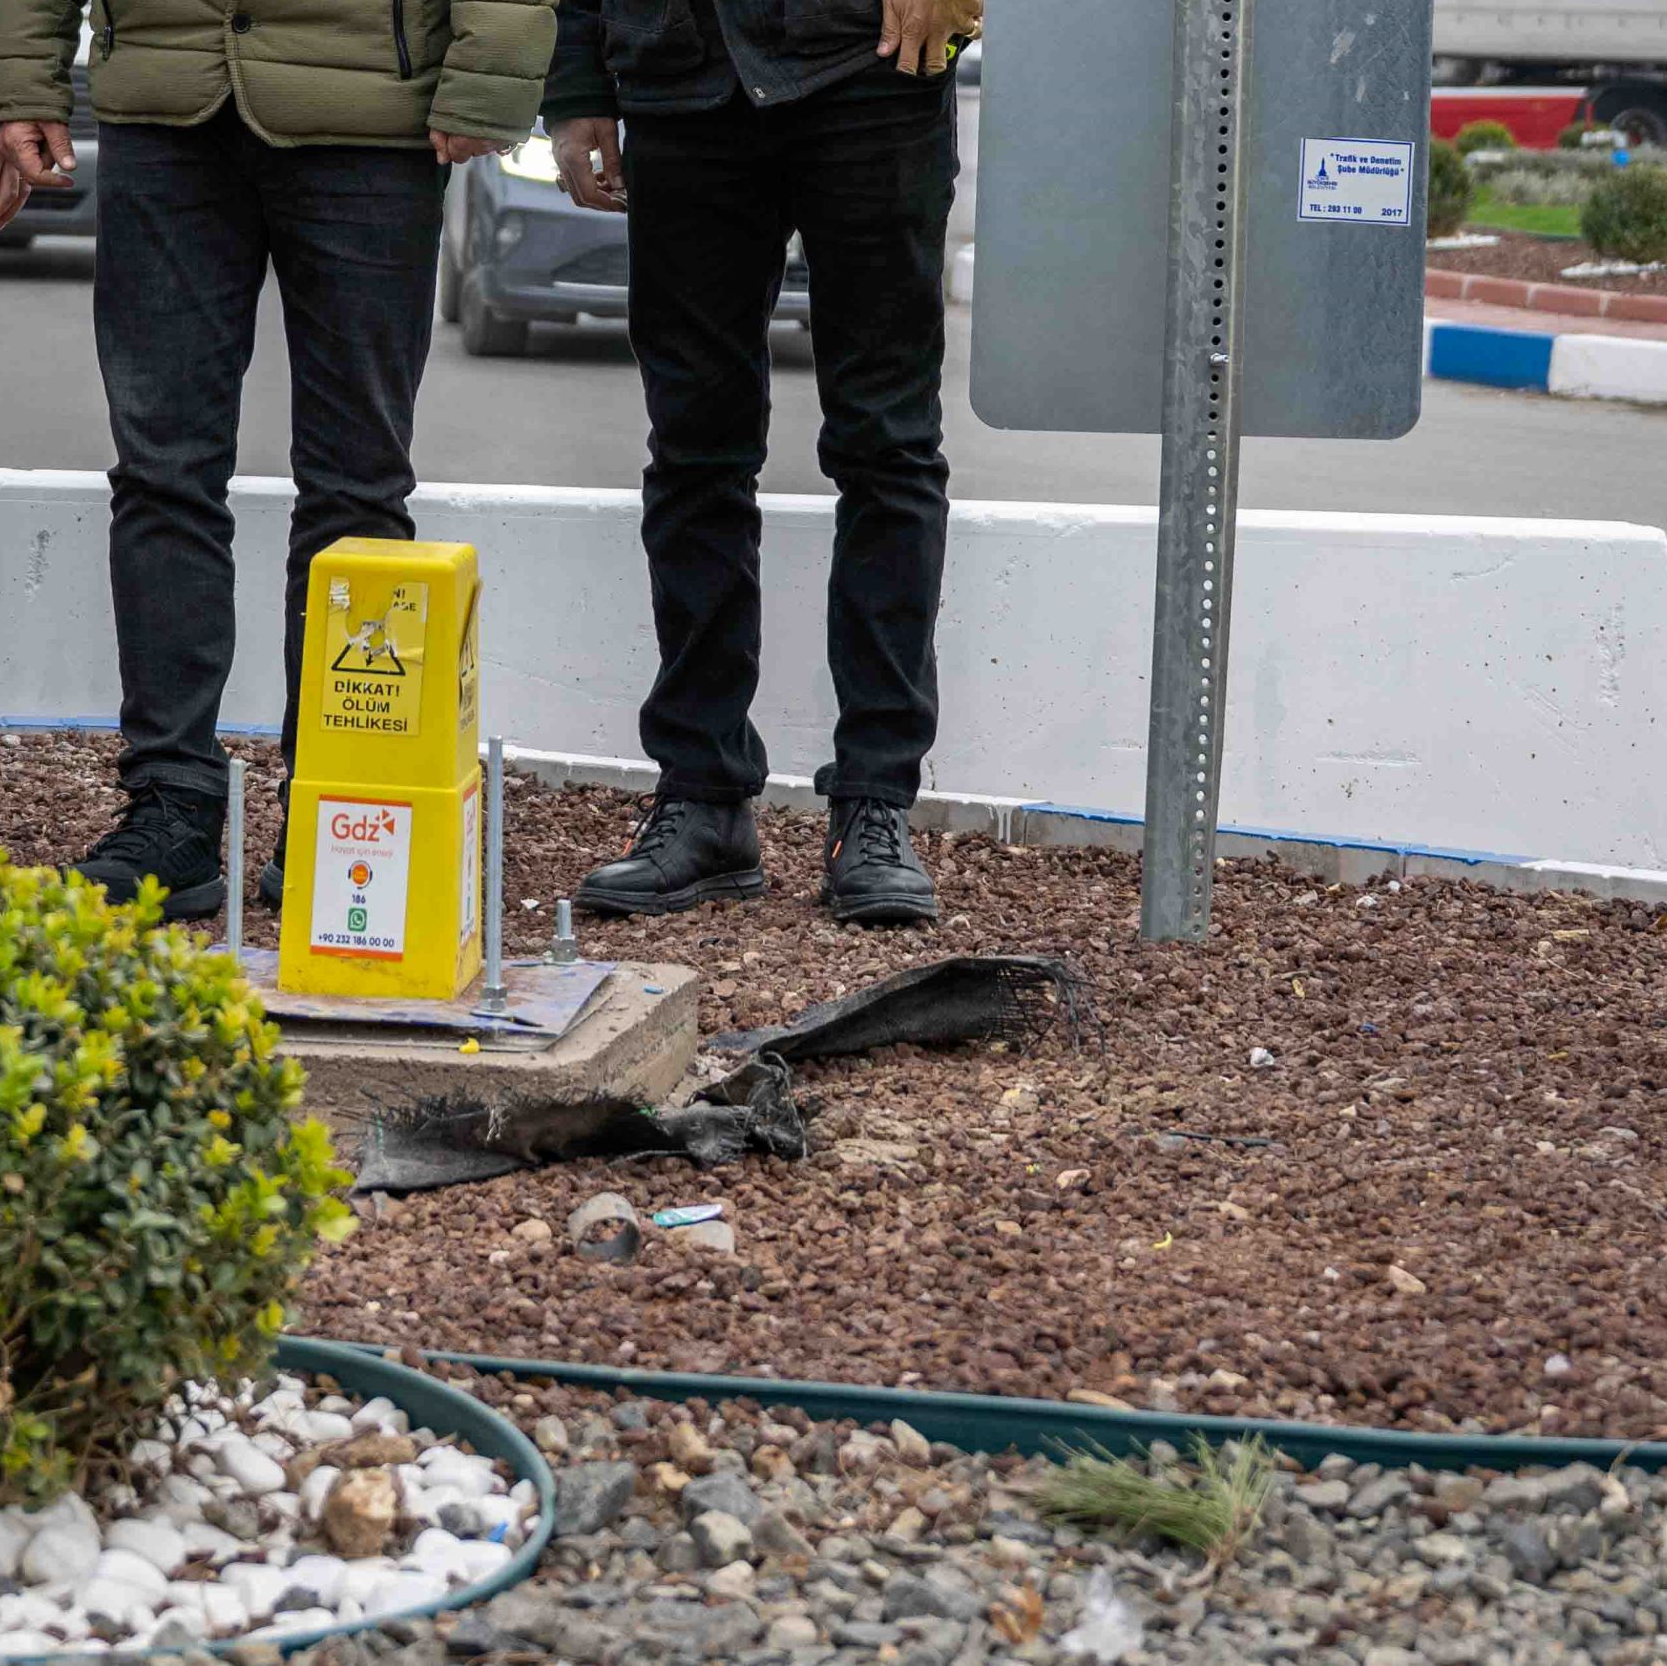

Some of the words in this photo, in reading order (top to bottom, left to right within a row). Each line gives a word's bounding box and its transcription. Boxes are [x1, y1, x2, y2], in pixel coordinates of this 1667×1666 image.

[1335, 154, 1357, 163] Trafik
[1370, 155, 1401, 165] Denetim
[1337, 165, 1357, 175] Şube
[1309, 203, 1322, 212] TEL
[1381, 208, 1403, 217] 2017
[334, 679, 400, 697] DİKKAT!
[342, 696, 390, 714] ÖLÜM
[323, 714, 409, 732] TEHLİKESİ
[331, 813, 380, 842] Gdz
[352, 894, 366, 904] 186
[318, 933, 334, 943] +90
[335, 934, 351, 944] 232
[352, 935, 367, 945] 186
[368, 937, 381, 946] 00
[382, 938, 395, 947] 00
